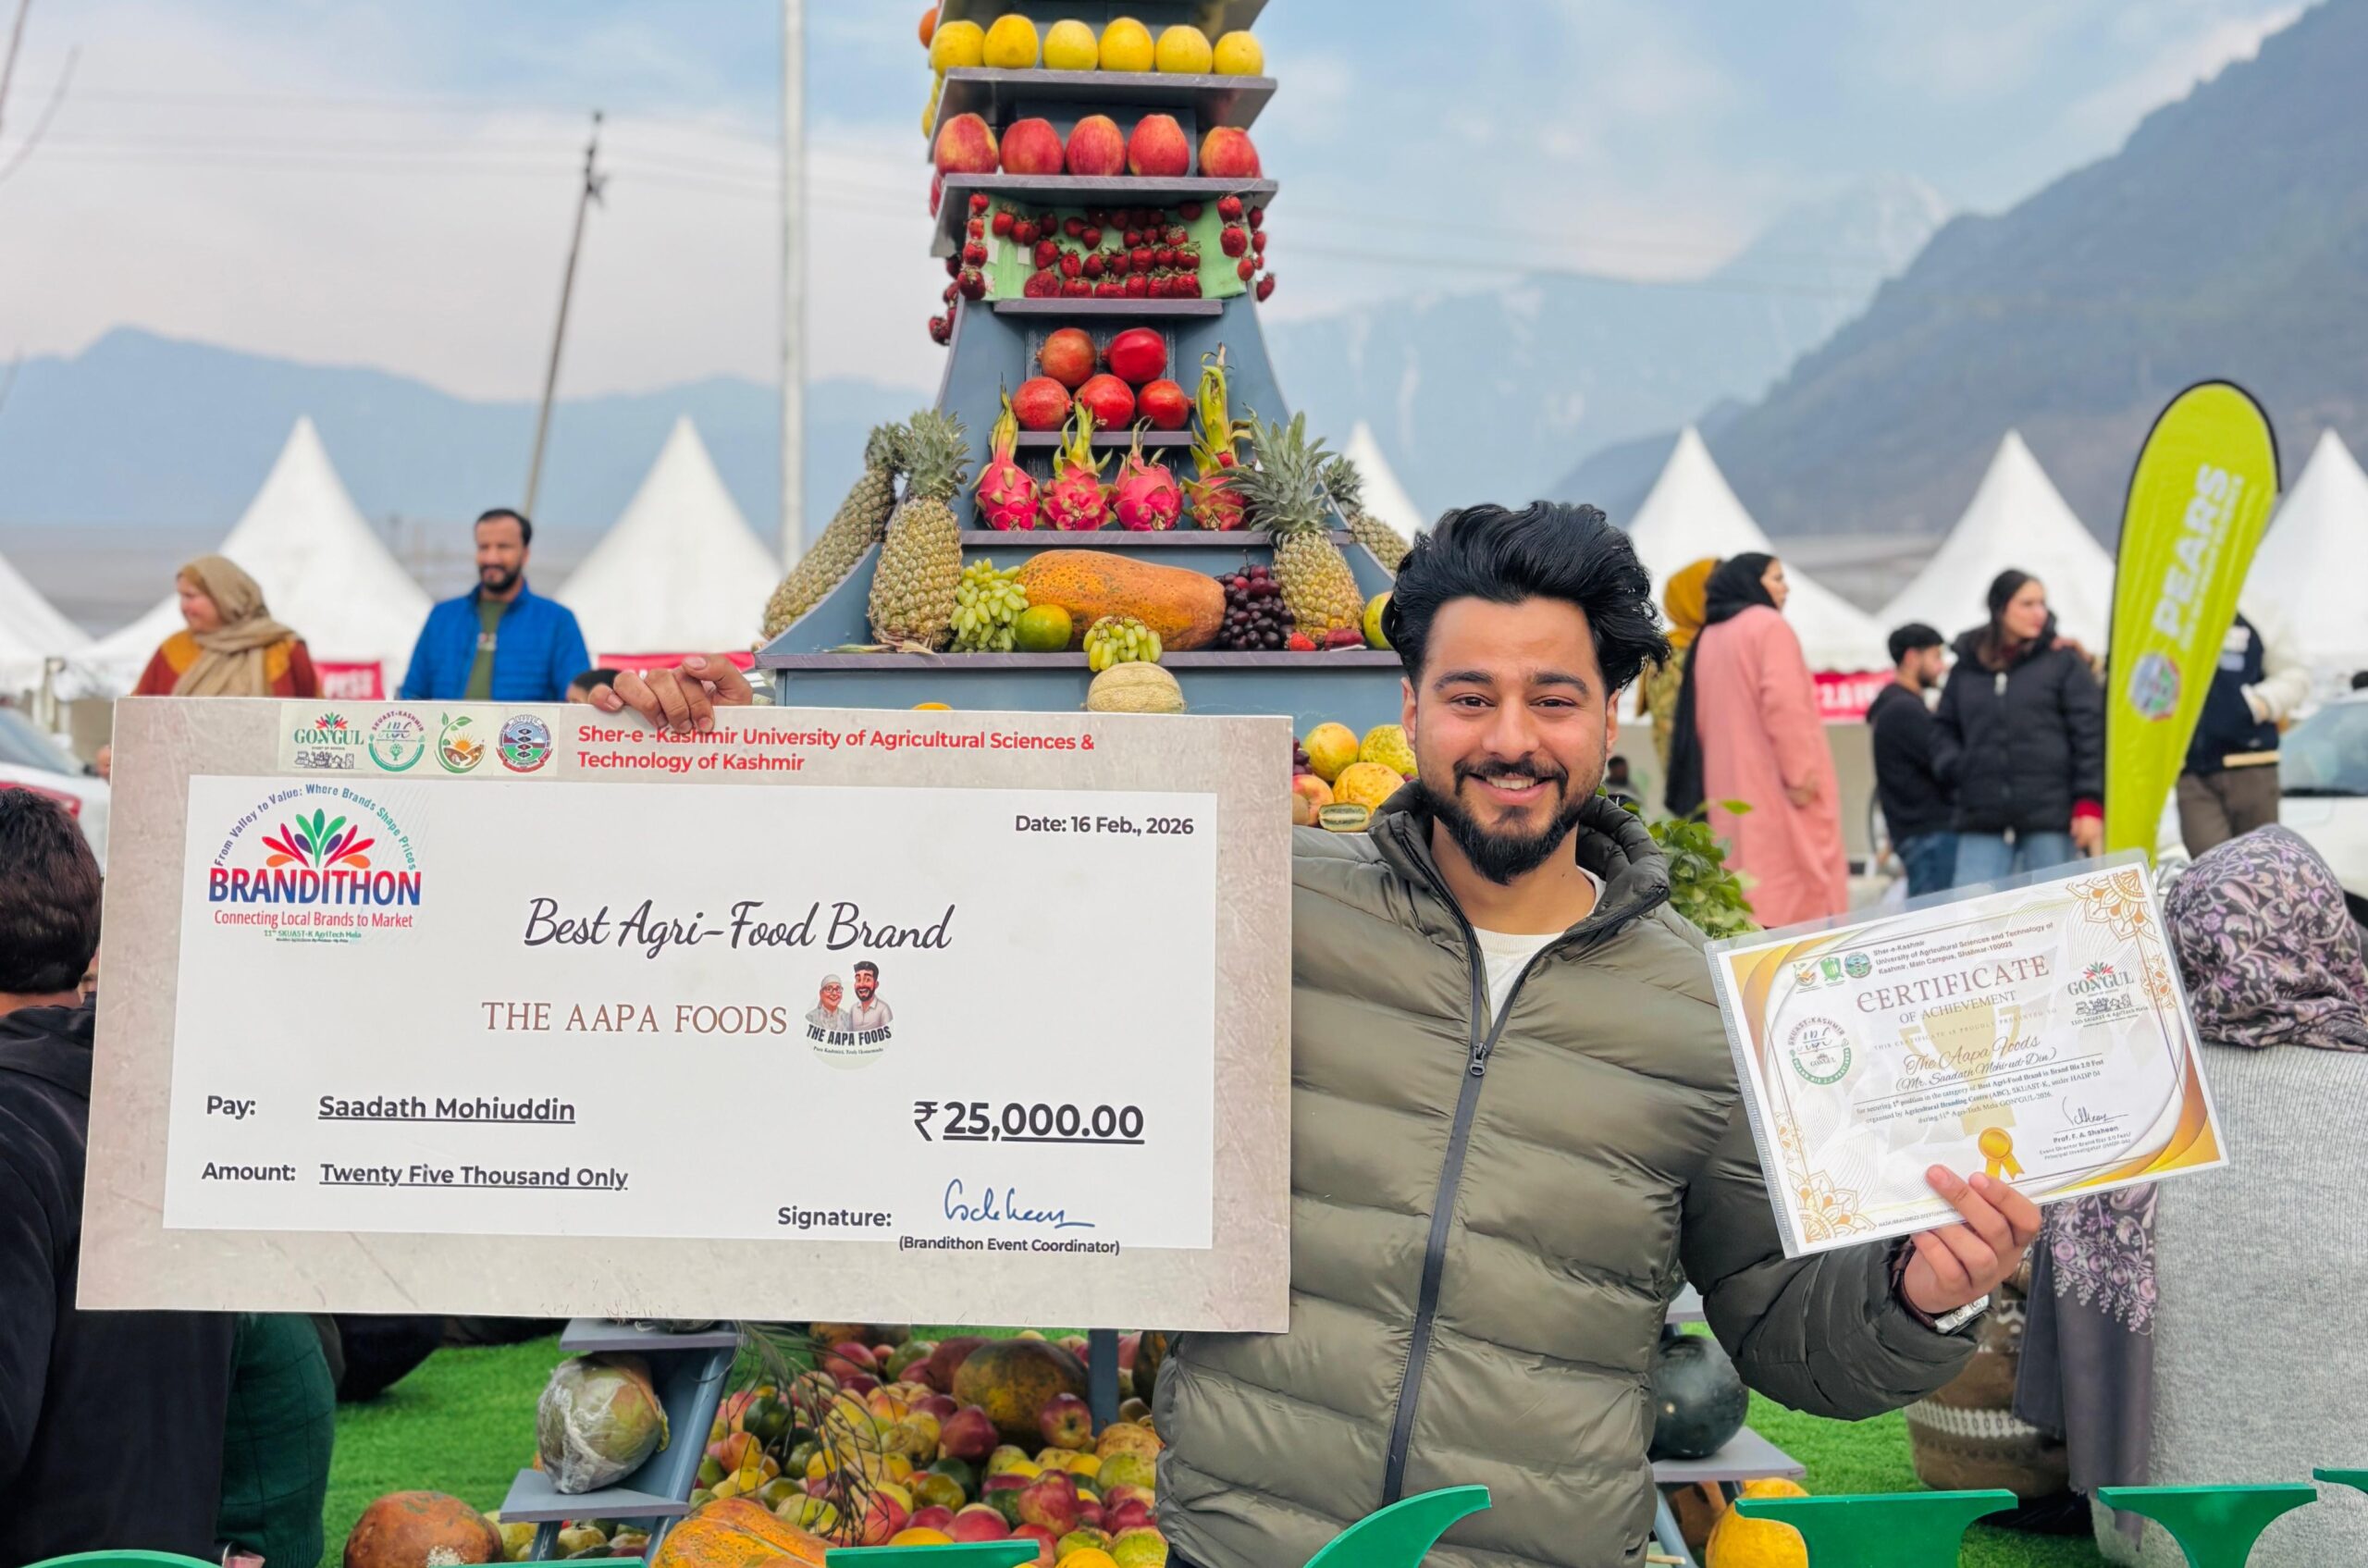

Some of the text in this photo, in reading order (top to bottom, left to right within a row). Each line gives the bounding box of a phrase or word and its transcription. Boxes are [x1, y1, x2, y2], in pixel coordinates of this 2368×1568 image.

[2152, 464, 2229, 639] PEARS
[578, 725, 644, 743] Sher-e
[743, 728, 841, 750] University
[845, 730, 866, 747] of
[870, 730, 985, 751] Agricultural
[990, 732, 1076, 750] Sciences
[1080, 735, 1095, 750] &
[577, 751, 805, 773] Technology of Kashmir
[214, 784, 416, 870] From Valley to Value: Where Brands Shape Prices
[1015, 815, 1194, 836] Date: 16 Feb., 2026
[208, 868, 422, 906] BRANDITHON
[215, 910, 413, 929] Connecting Local Brands to Market
[524, 897, 956, 959] Best Agri-Food Brand
[1876, 953, 1910, 965] University
[1919, 942, 1958, 957] Agricultural
[1959, 937, 1990, 947] Sciences
[2006, 925, 2045, 938] Technology
[1857, 956, 2050, 1013] CERTIFICATE
[482, 1002, 788, 1034] THE AAPA FOODS
[1899, 991, 2016, 1023] OF ACHIEVEMENT
[807, 1024, 892, 1046] THE AAPA FOODS
[1904, 1035, 2041, 1076] The Aapa Foods
[206, 1095, 256, 1120] Pay:
[318, 1095, 575, 1122] Saadath Mohiuddin
[2054, 1134, 2071, 1143] Prof.
[202, 1162, 296, 1182] Amount:
[320, 1163, 628, 1191] Twenty Five Thousand Only
[778, 1206, 892, 1229] Signature:
[899, 1236, 1120, 1256] (Brandithon Event Coordinator)
